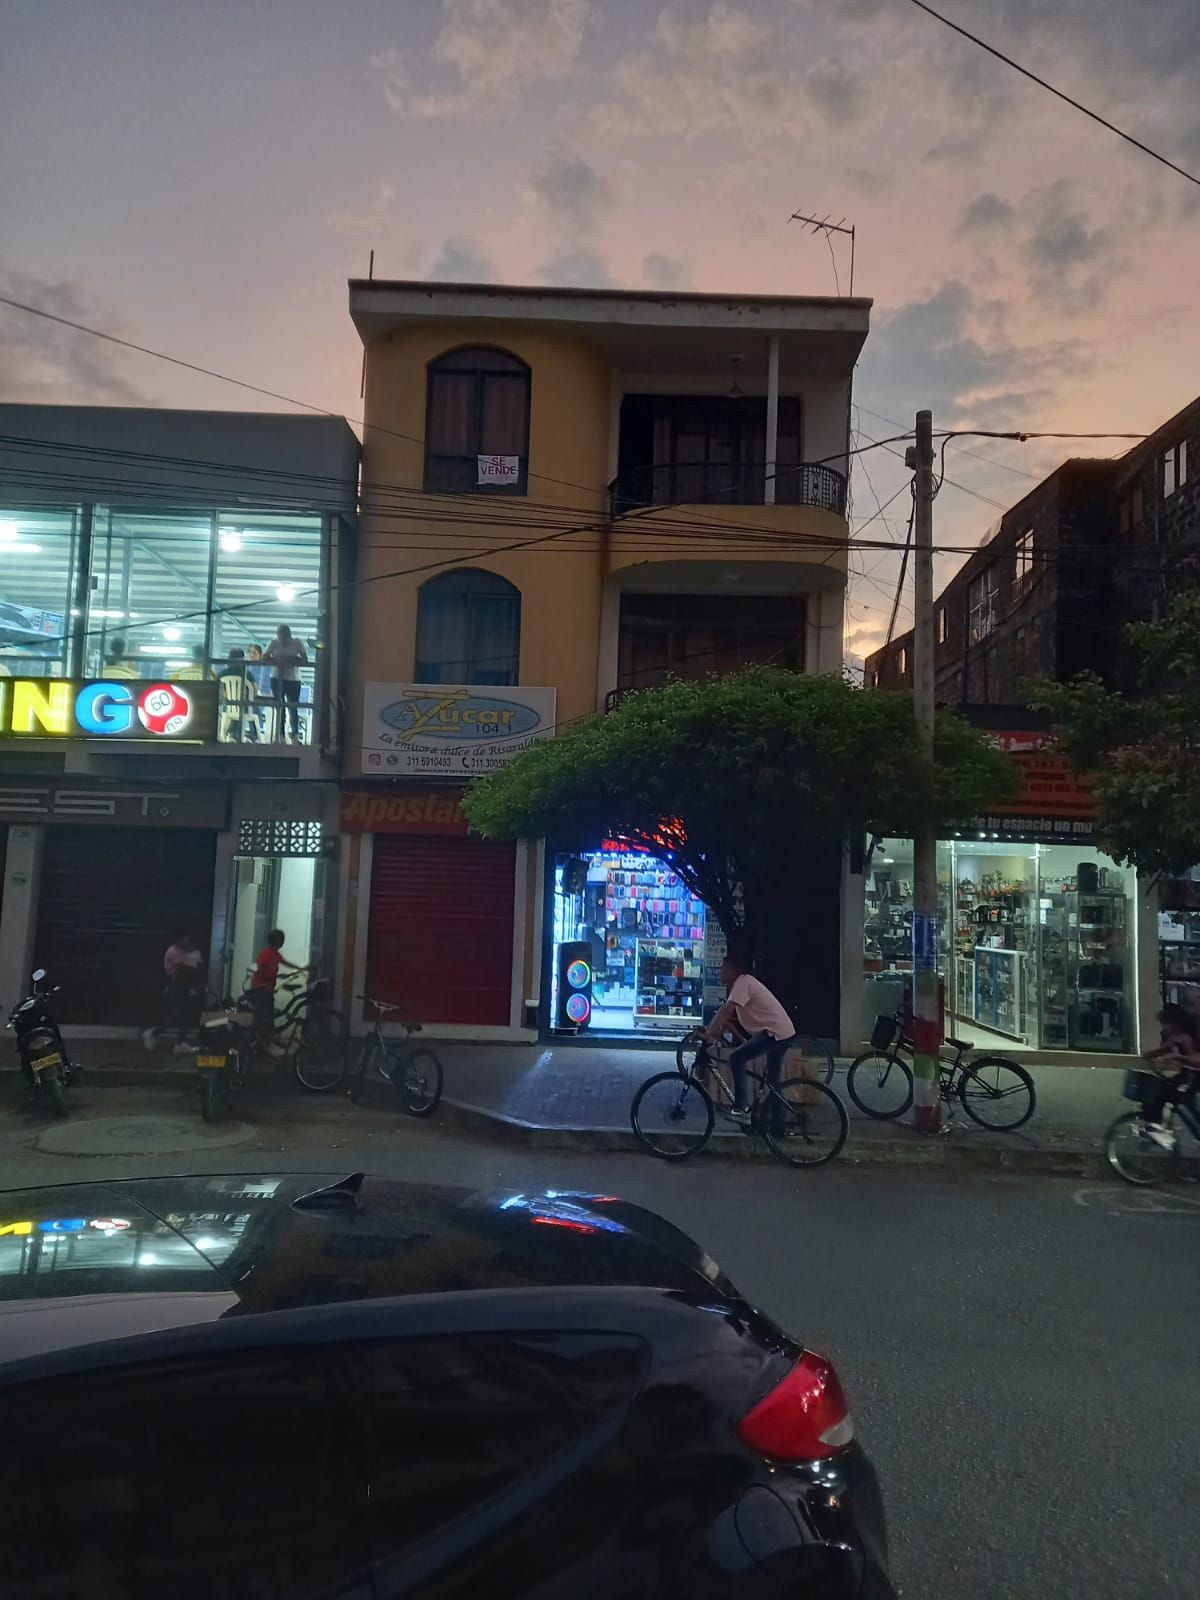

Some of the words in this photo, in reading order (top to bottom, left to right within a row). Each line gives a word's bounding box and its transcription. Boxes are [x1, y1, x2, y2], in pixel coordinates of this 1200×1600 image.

[492, 457, 506, 466] SE
[481, 466, 517, 475] VENDE
[150, 692, 171, 711] 60
[475, 724, 498, 734] 104
[378, 733, 393, 744] La
[395, 740, 438, 754] emisora
[440, 745, 469, 756] dulce
[473, 747, 485, 756] de
[407, 756, 419, 766] 311
[471, 758, 483, 767] 311
[970, 815, 986, 829] de
[987, 815, 1001, 829] tu
[1002, 816, 1054, 832] espacio
[1054, 820, 1071, 833] un
